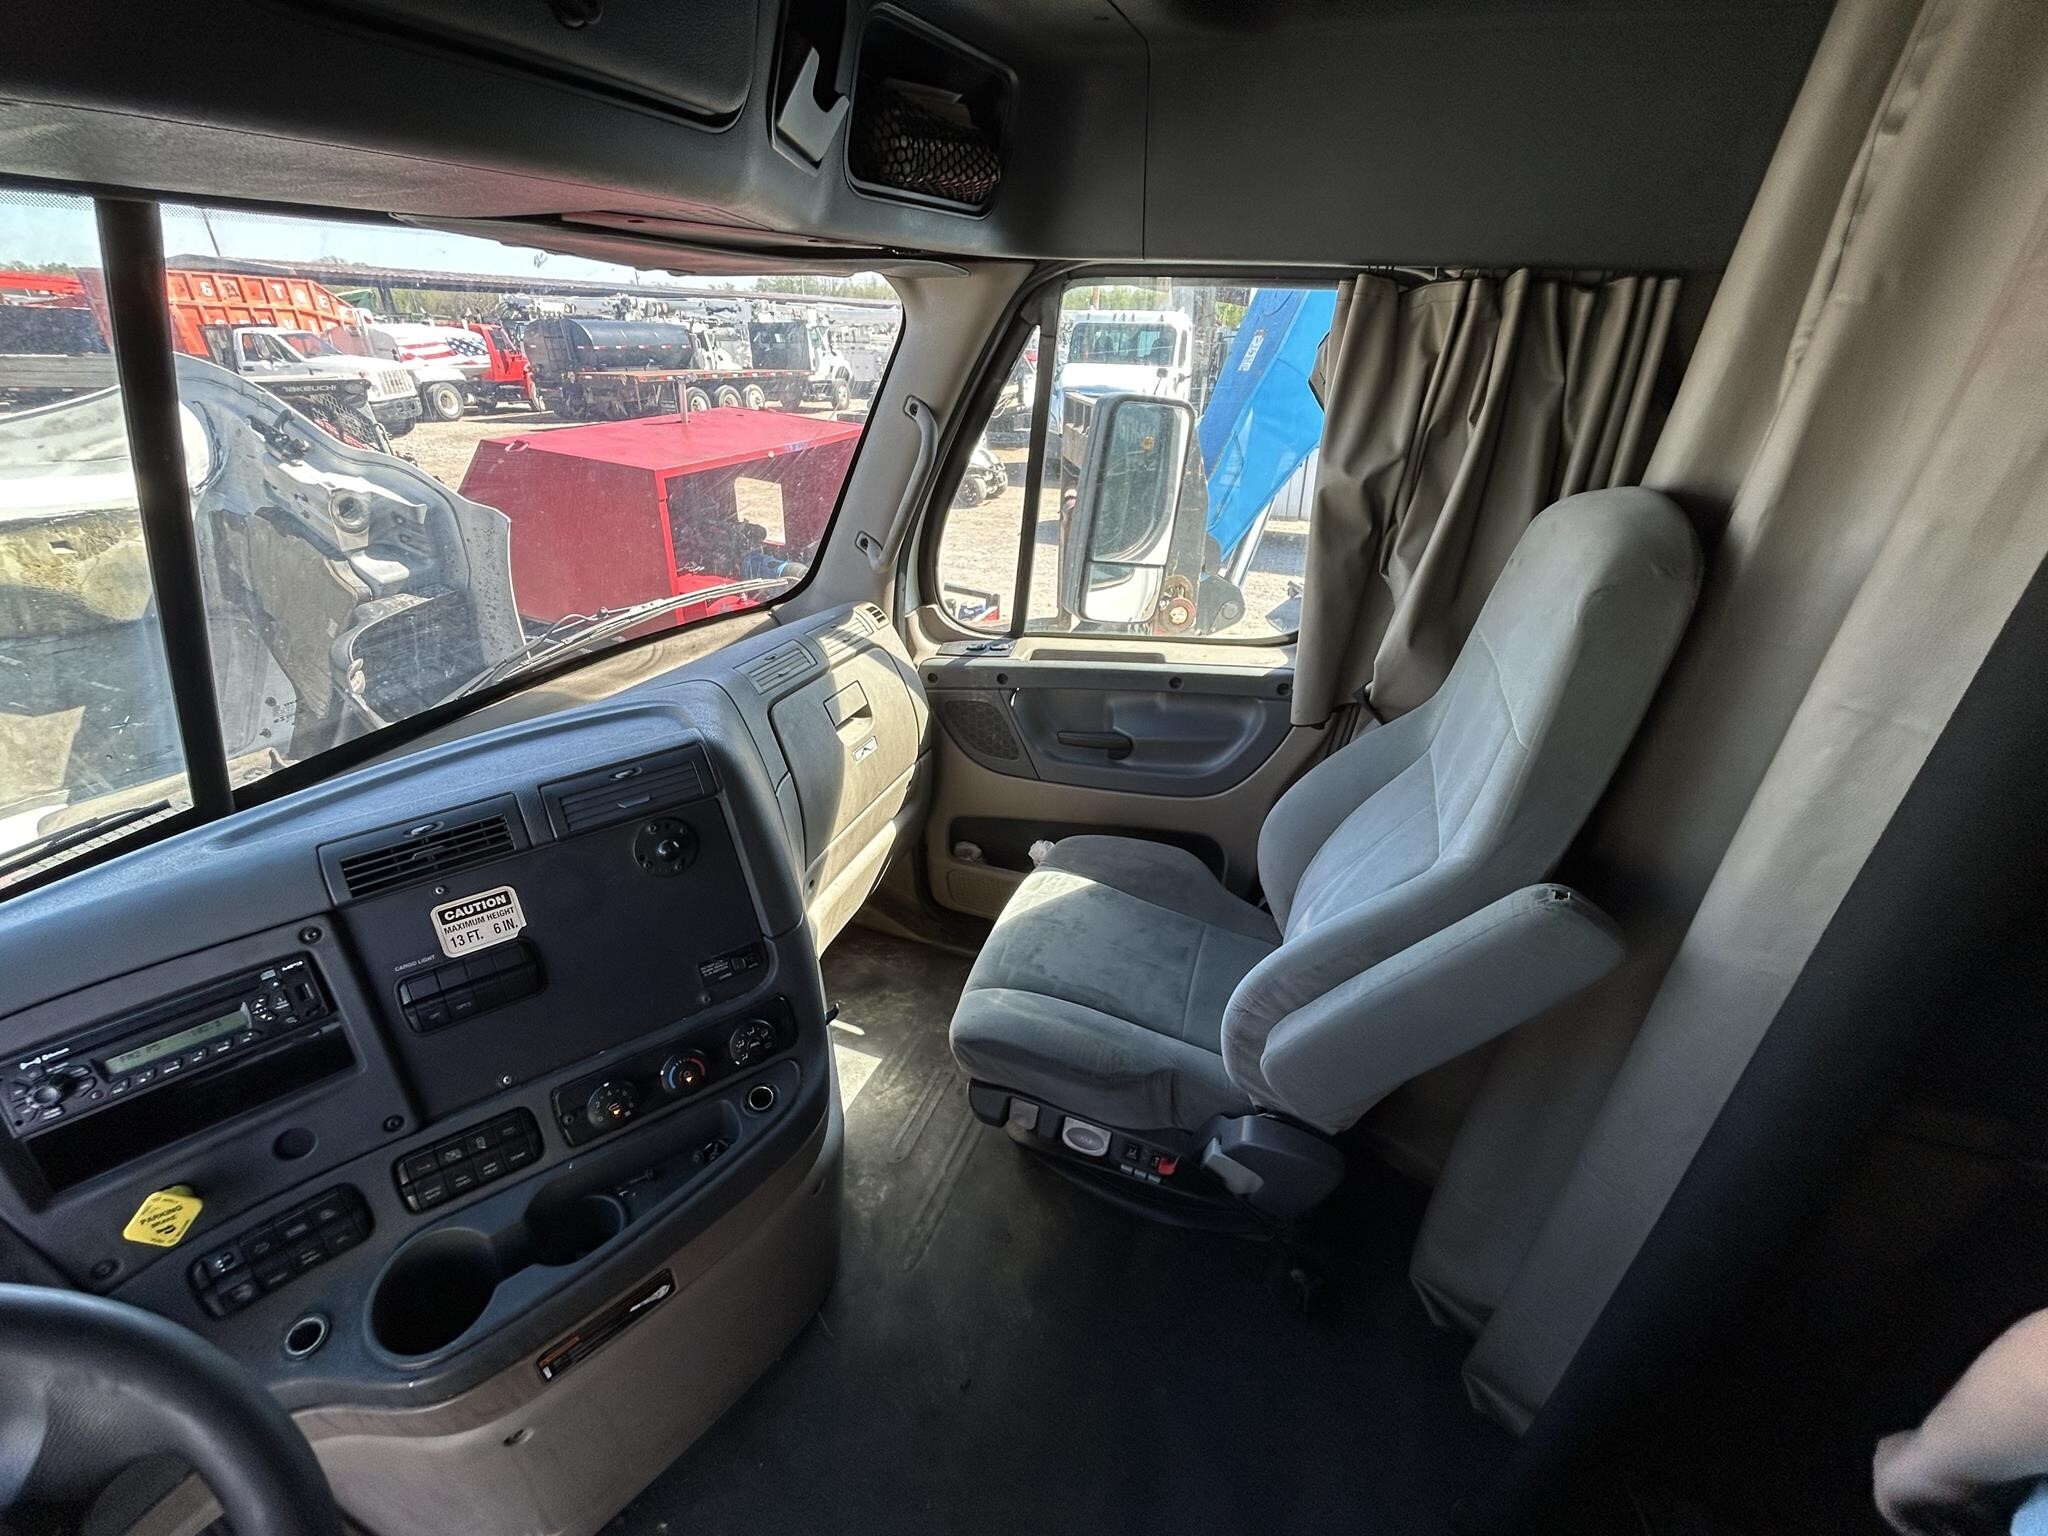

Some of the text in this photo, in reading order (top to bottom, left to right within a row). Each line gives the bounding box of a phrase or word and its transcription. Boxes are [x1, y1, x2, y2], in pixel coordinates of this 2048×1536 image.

[444, 894, 507, 920] CAUTION
[443, 907, 515, 935] MAXIMUM HEIGHT
[450, 918, 518, 948] 13 FT. 6 IN.
[394, 954, 435, 972] CARGO LIGHT
[140, 1205, 183, 1226] PARKING
